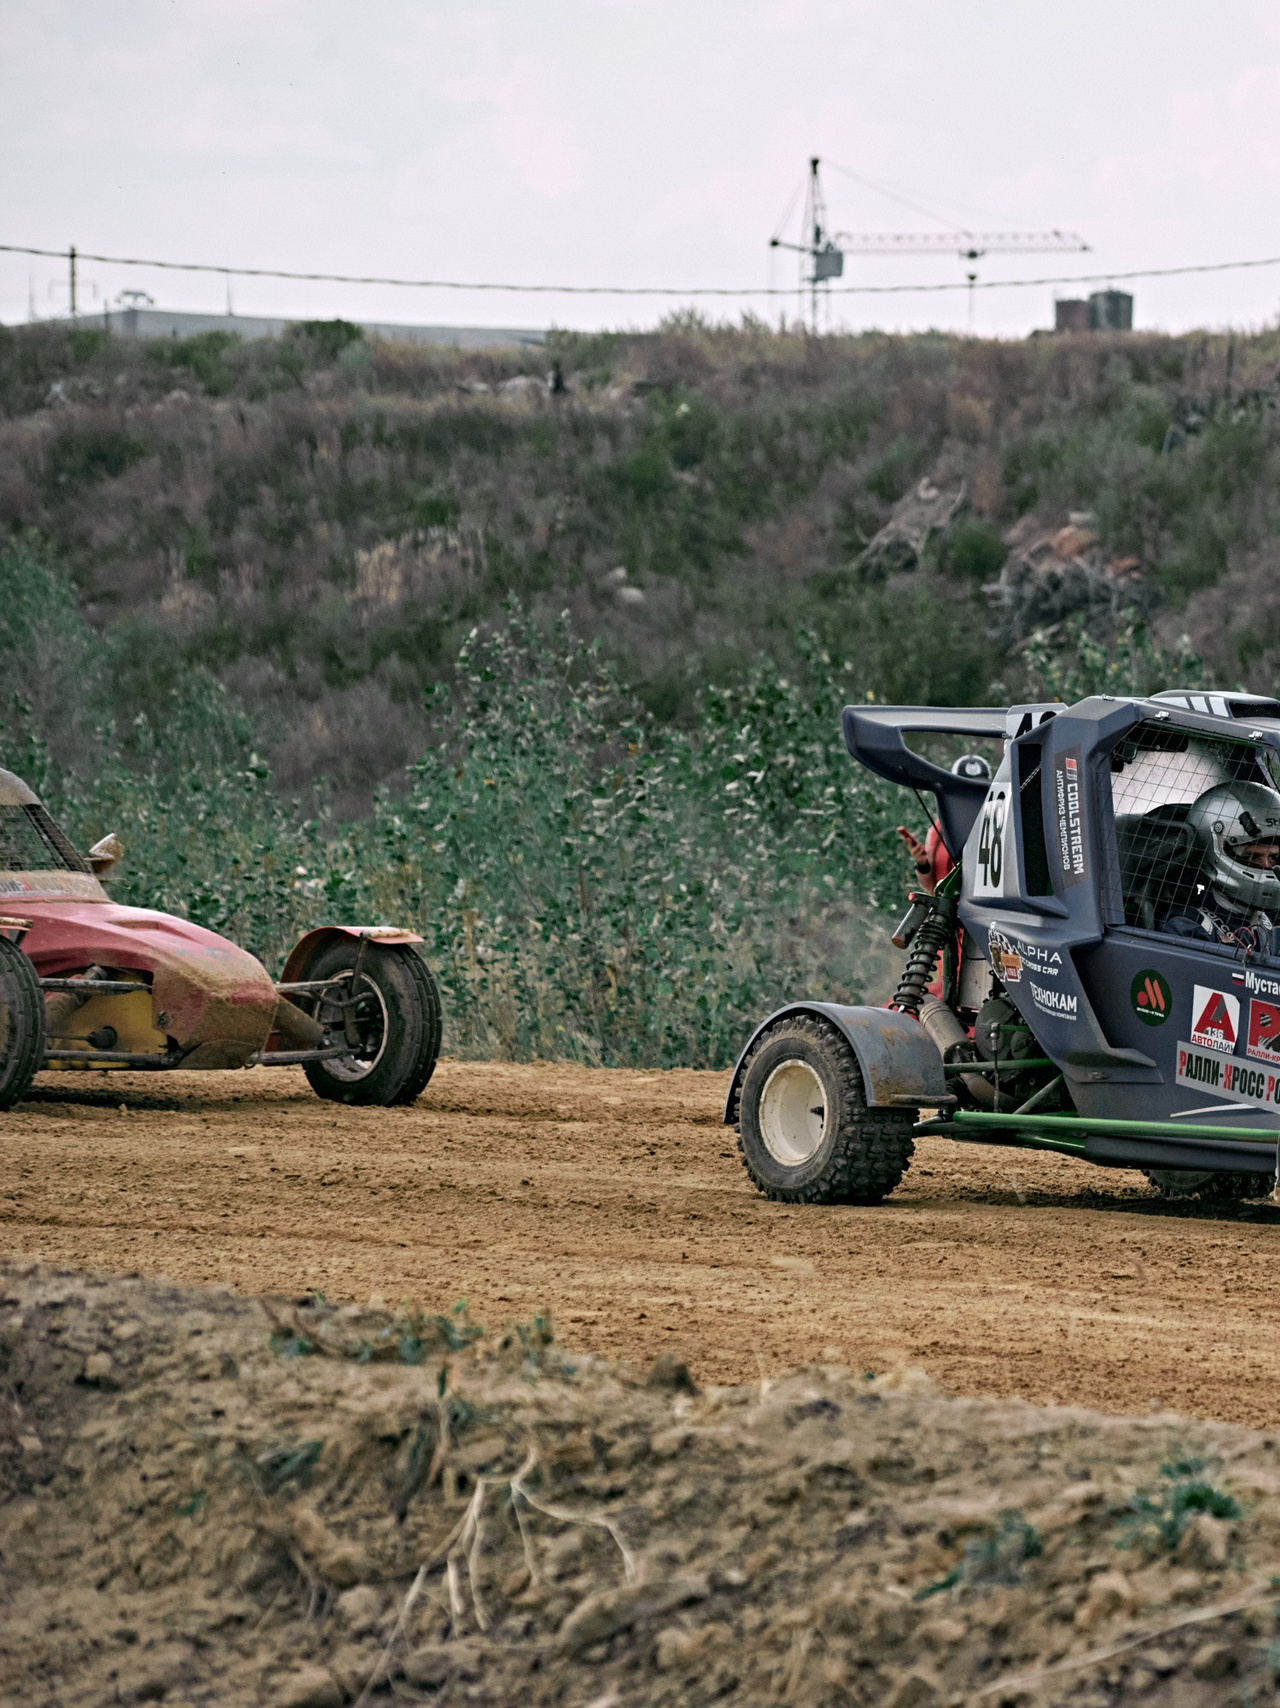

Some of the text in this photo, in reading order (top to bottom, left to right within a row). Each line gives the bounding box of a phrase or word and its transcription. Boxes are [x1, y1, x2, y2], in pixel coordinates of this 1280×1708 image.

[978, 791, 1006, 888] 48
[1056, 769, 1071, 871] АНТИФРИЗ ЧЕМПИОНОВ
[1067, 783, 1084, 875] COOLSTREAM
[1017, 940, 1063, 965] ALPHA
[1042, 966, 1059, 976] CAR
[1029, 981, 1078, 1013] ТЕХНОКАМ
[1178, 1050, 1265, 1099] РАЛЛИ-КРОСС
